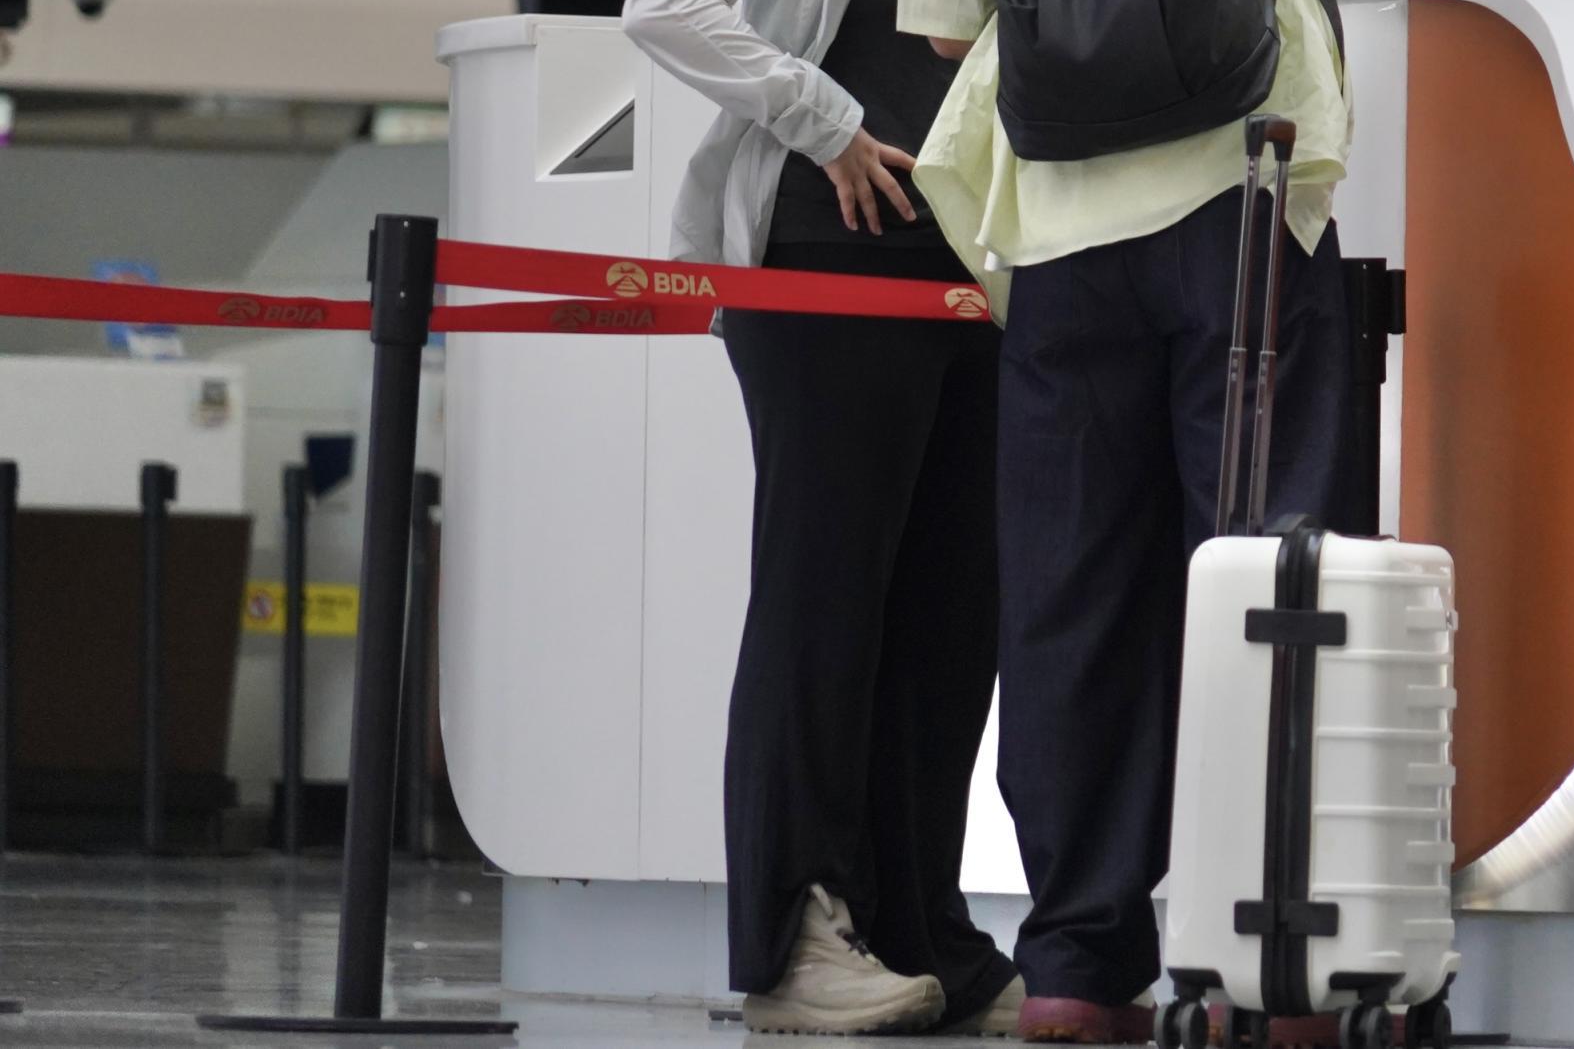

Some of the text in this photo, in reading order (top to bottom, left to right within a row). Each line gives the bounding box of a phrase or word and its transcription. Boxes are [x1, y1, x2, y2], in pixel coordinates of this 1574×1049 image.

[653, 270, 717, 298] BDIA
[263, 303, 328, 325] BDIA
[592, 306, 657, 329] BDIA
